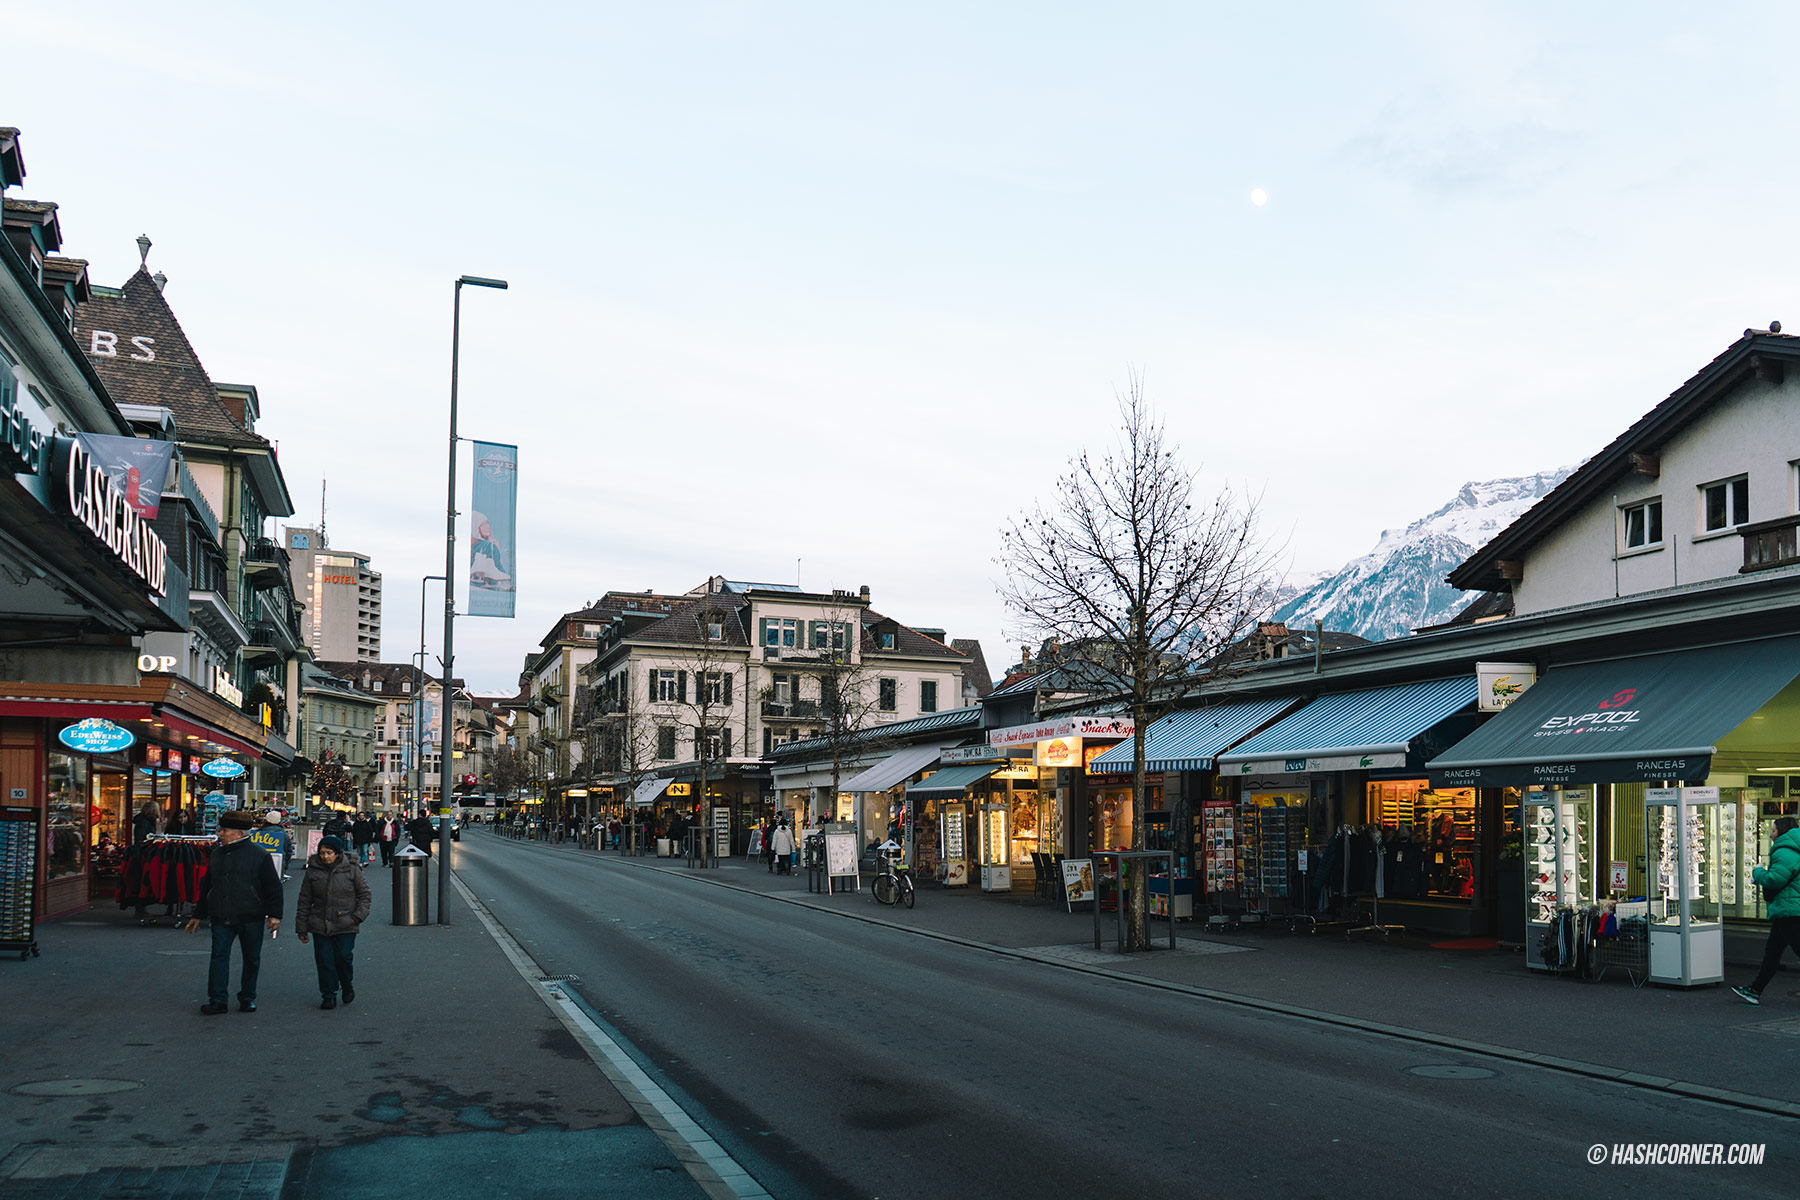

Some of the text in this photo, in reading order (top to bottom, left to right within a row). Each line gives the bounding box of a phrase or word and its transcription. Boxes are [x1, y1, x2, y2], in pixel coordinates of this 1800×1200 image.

[68, 438, 167, 597] CASAGRANDE
[323, 574, 357, 585] HOTEL
[1080, 721, 1113, 734] Snack
[1533, 725, 1628, 737] SWISS MADE
[1533, 765, 1577, 774] RANCEAS
[1636, 759, 1686, 770] RANCEAS
[1444, 769, 1481, 778] RANCEAS
